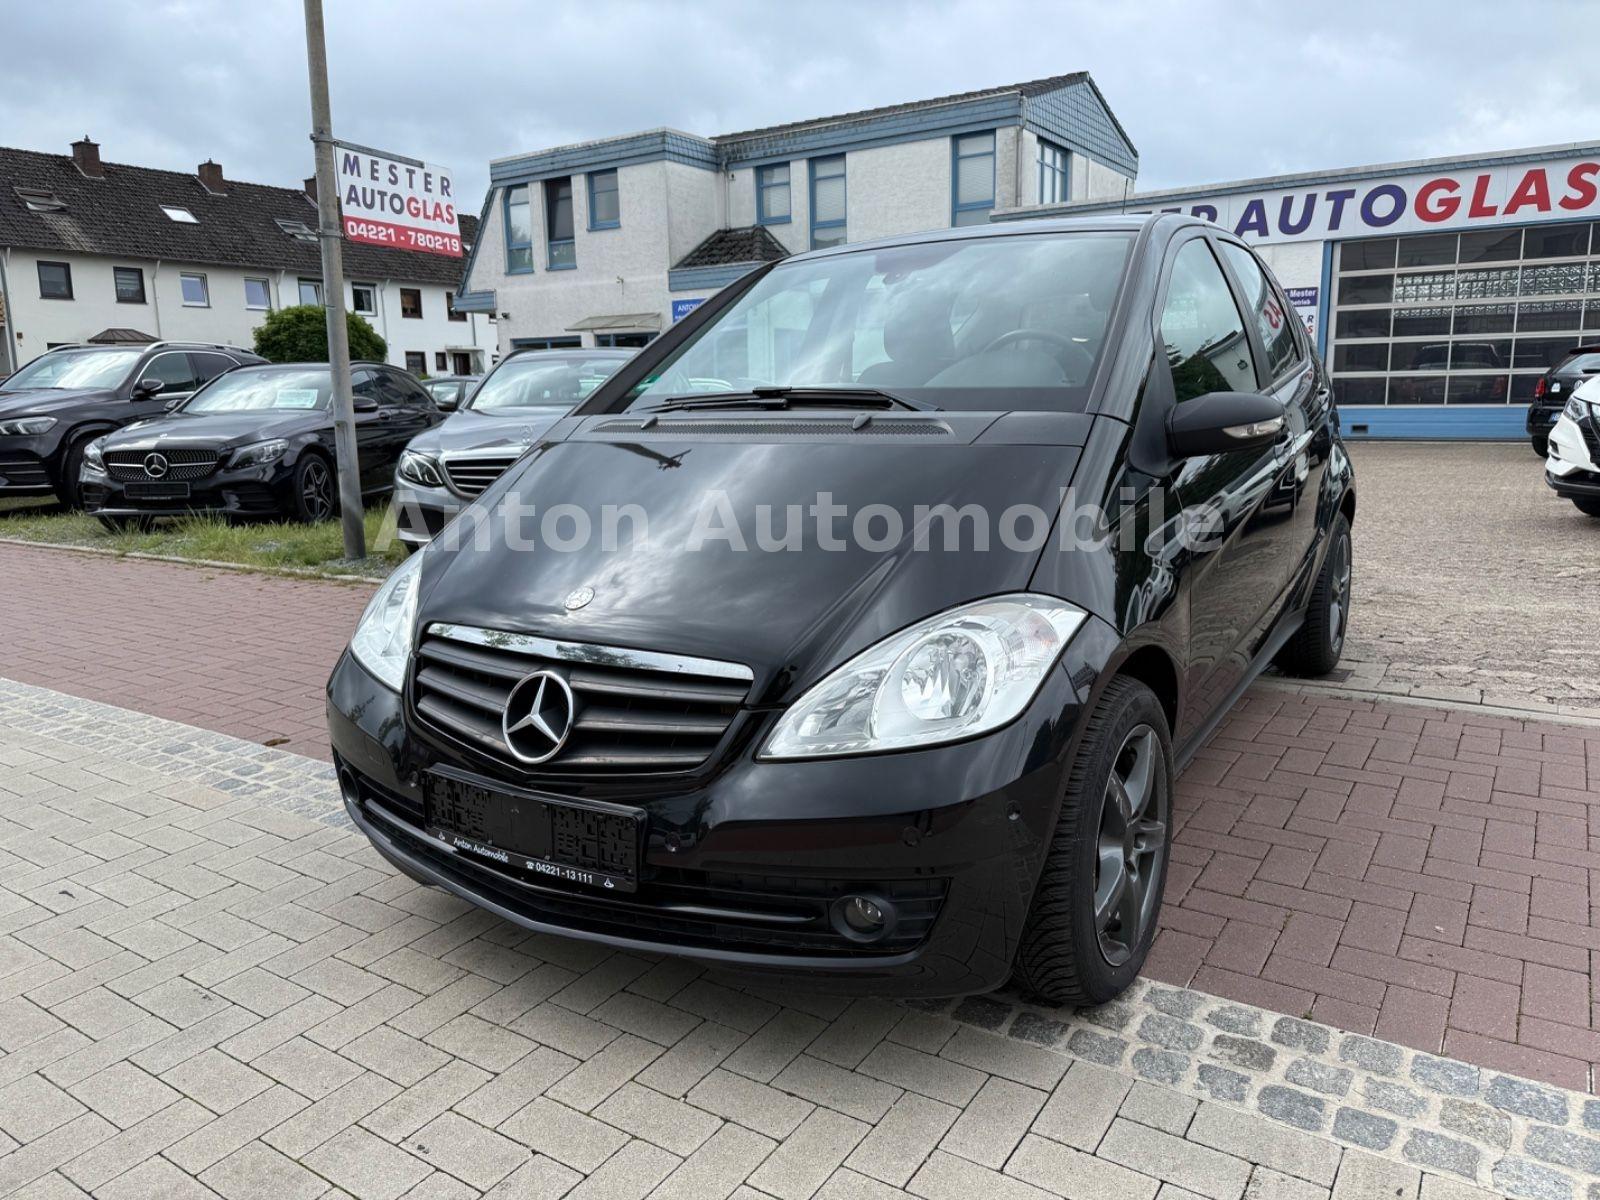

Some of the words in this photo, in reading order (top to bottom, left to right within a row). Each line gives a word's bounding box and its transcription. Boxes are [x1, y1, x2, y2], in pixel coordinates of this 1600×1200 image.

[342, 152, 451, 197] MESTER
[345, 184, 455, 225] AUTOGLAS
[1234, 162, 1600, 238] AUTOGLAS
[1290, 290, 1316, 298] Mester
[453, 837, 473, 850] Anton
[473, 844, 509, 863] Automobile
